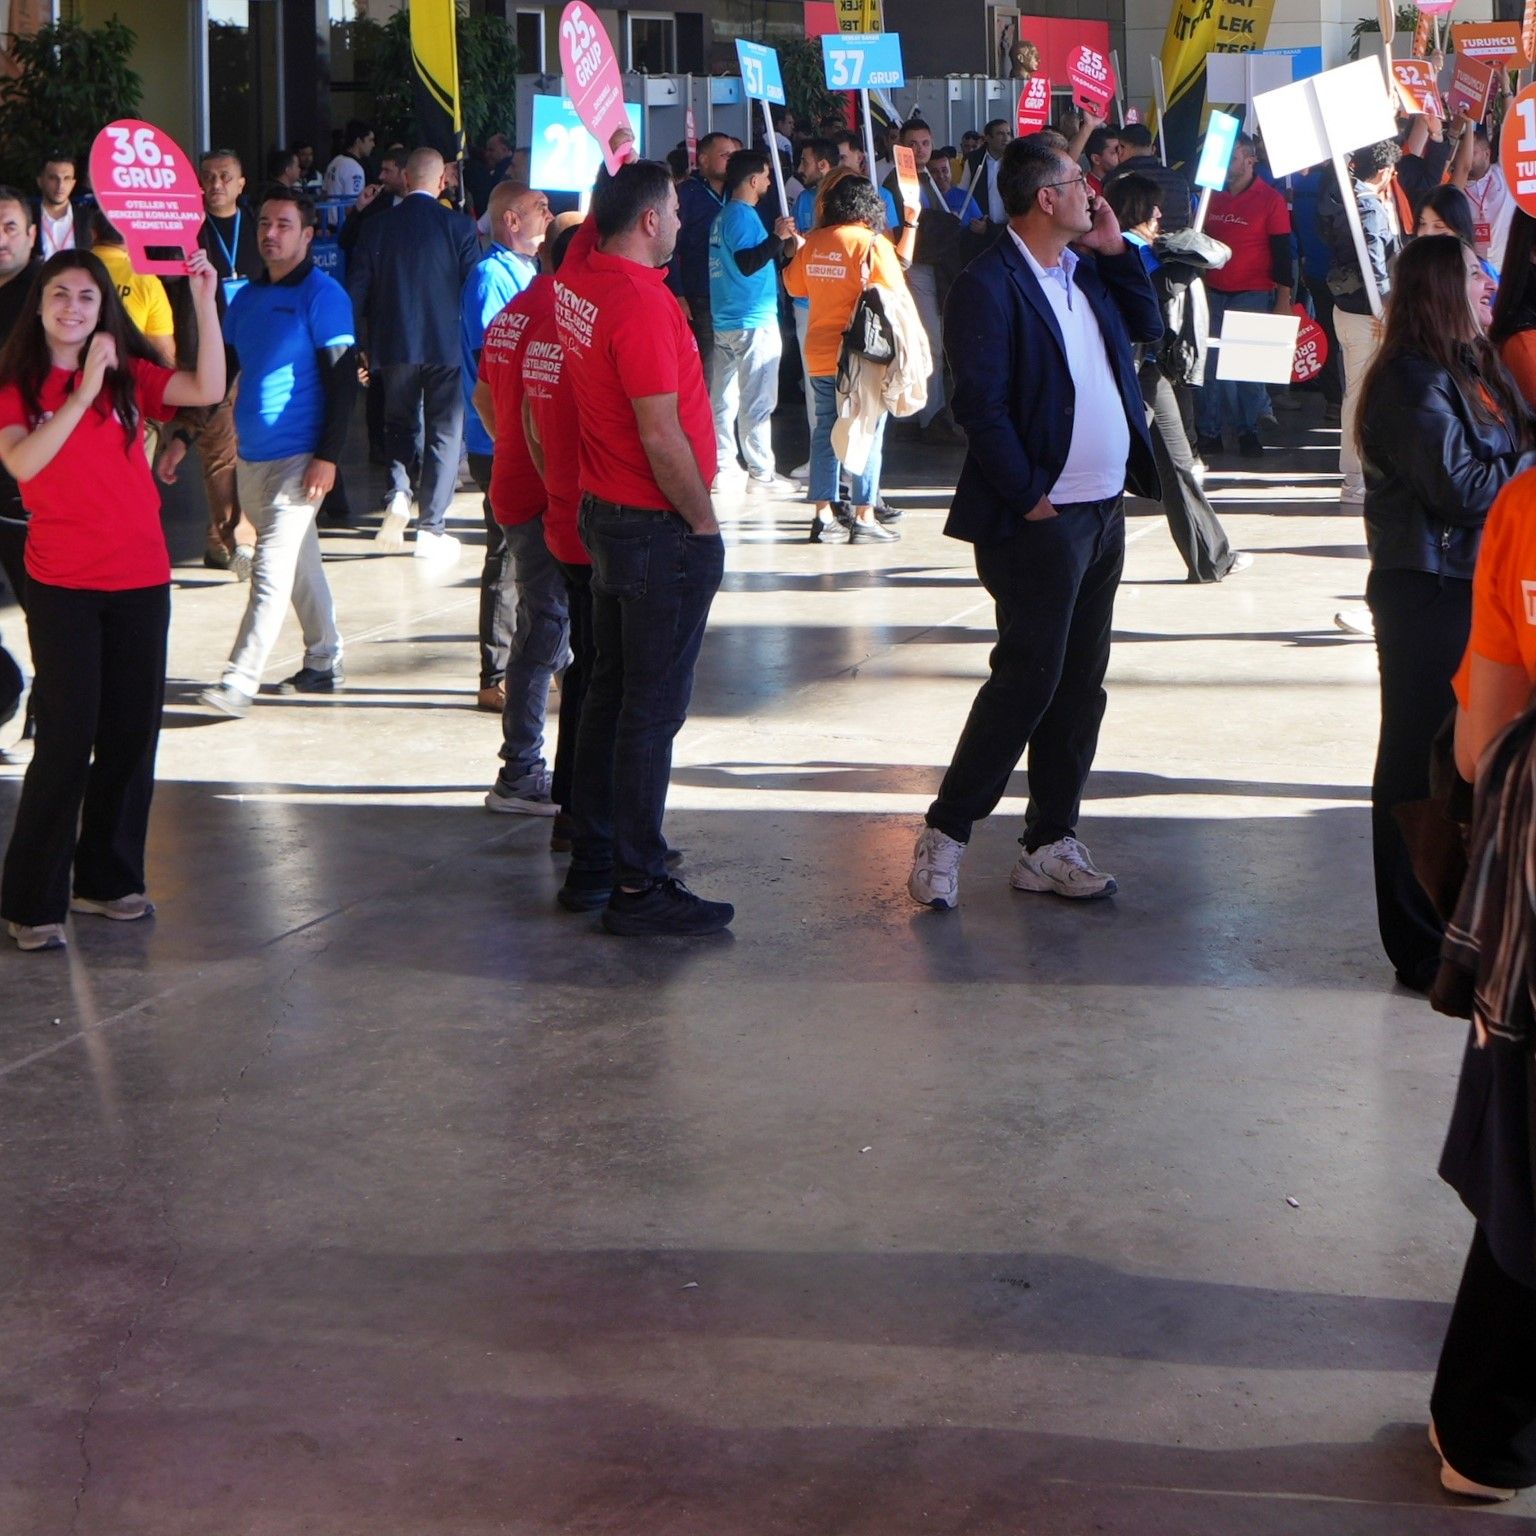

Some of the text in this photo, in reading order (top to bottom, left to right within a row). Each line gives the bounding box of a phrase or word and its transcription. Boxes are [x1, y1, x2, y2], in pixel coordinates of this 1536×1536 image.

[563, 5, 596, 64] 25.
[1460, 36, 1515, 47] TURUNCU
[575, 41, 602, 88] GRUP
[829, 49, 864, 86] 37
[1076, 61, 1106, 81] GRUP
[1080, 45, 1107, 74] 35.
[741, 56, 764, 95] 37
[1395, 66, 1427, 88] 32.
[1456, 68, 1485, 92] TURUNCU
[1028, 77, 1046, 99] 35.
[106, 127, 174, 167] 36.
[112, 166, 176, 190] GRUP
[125, 200, 179, 210] OTELLER VE
[145, 210, 200, 221] KONAKLAMA
[131, 219, 183, 231] HİZMETLERİ
[1297, 351, 1322, 381] 35
